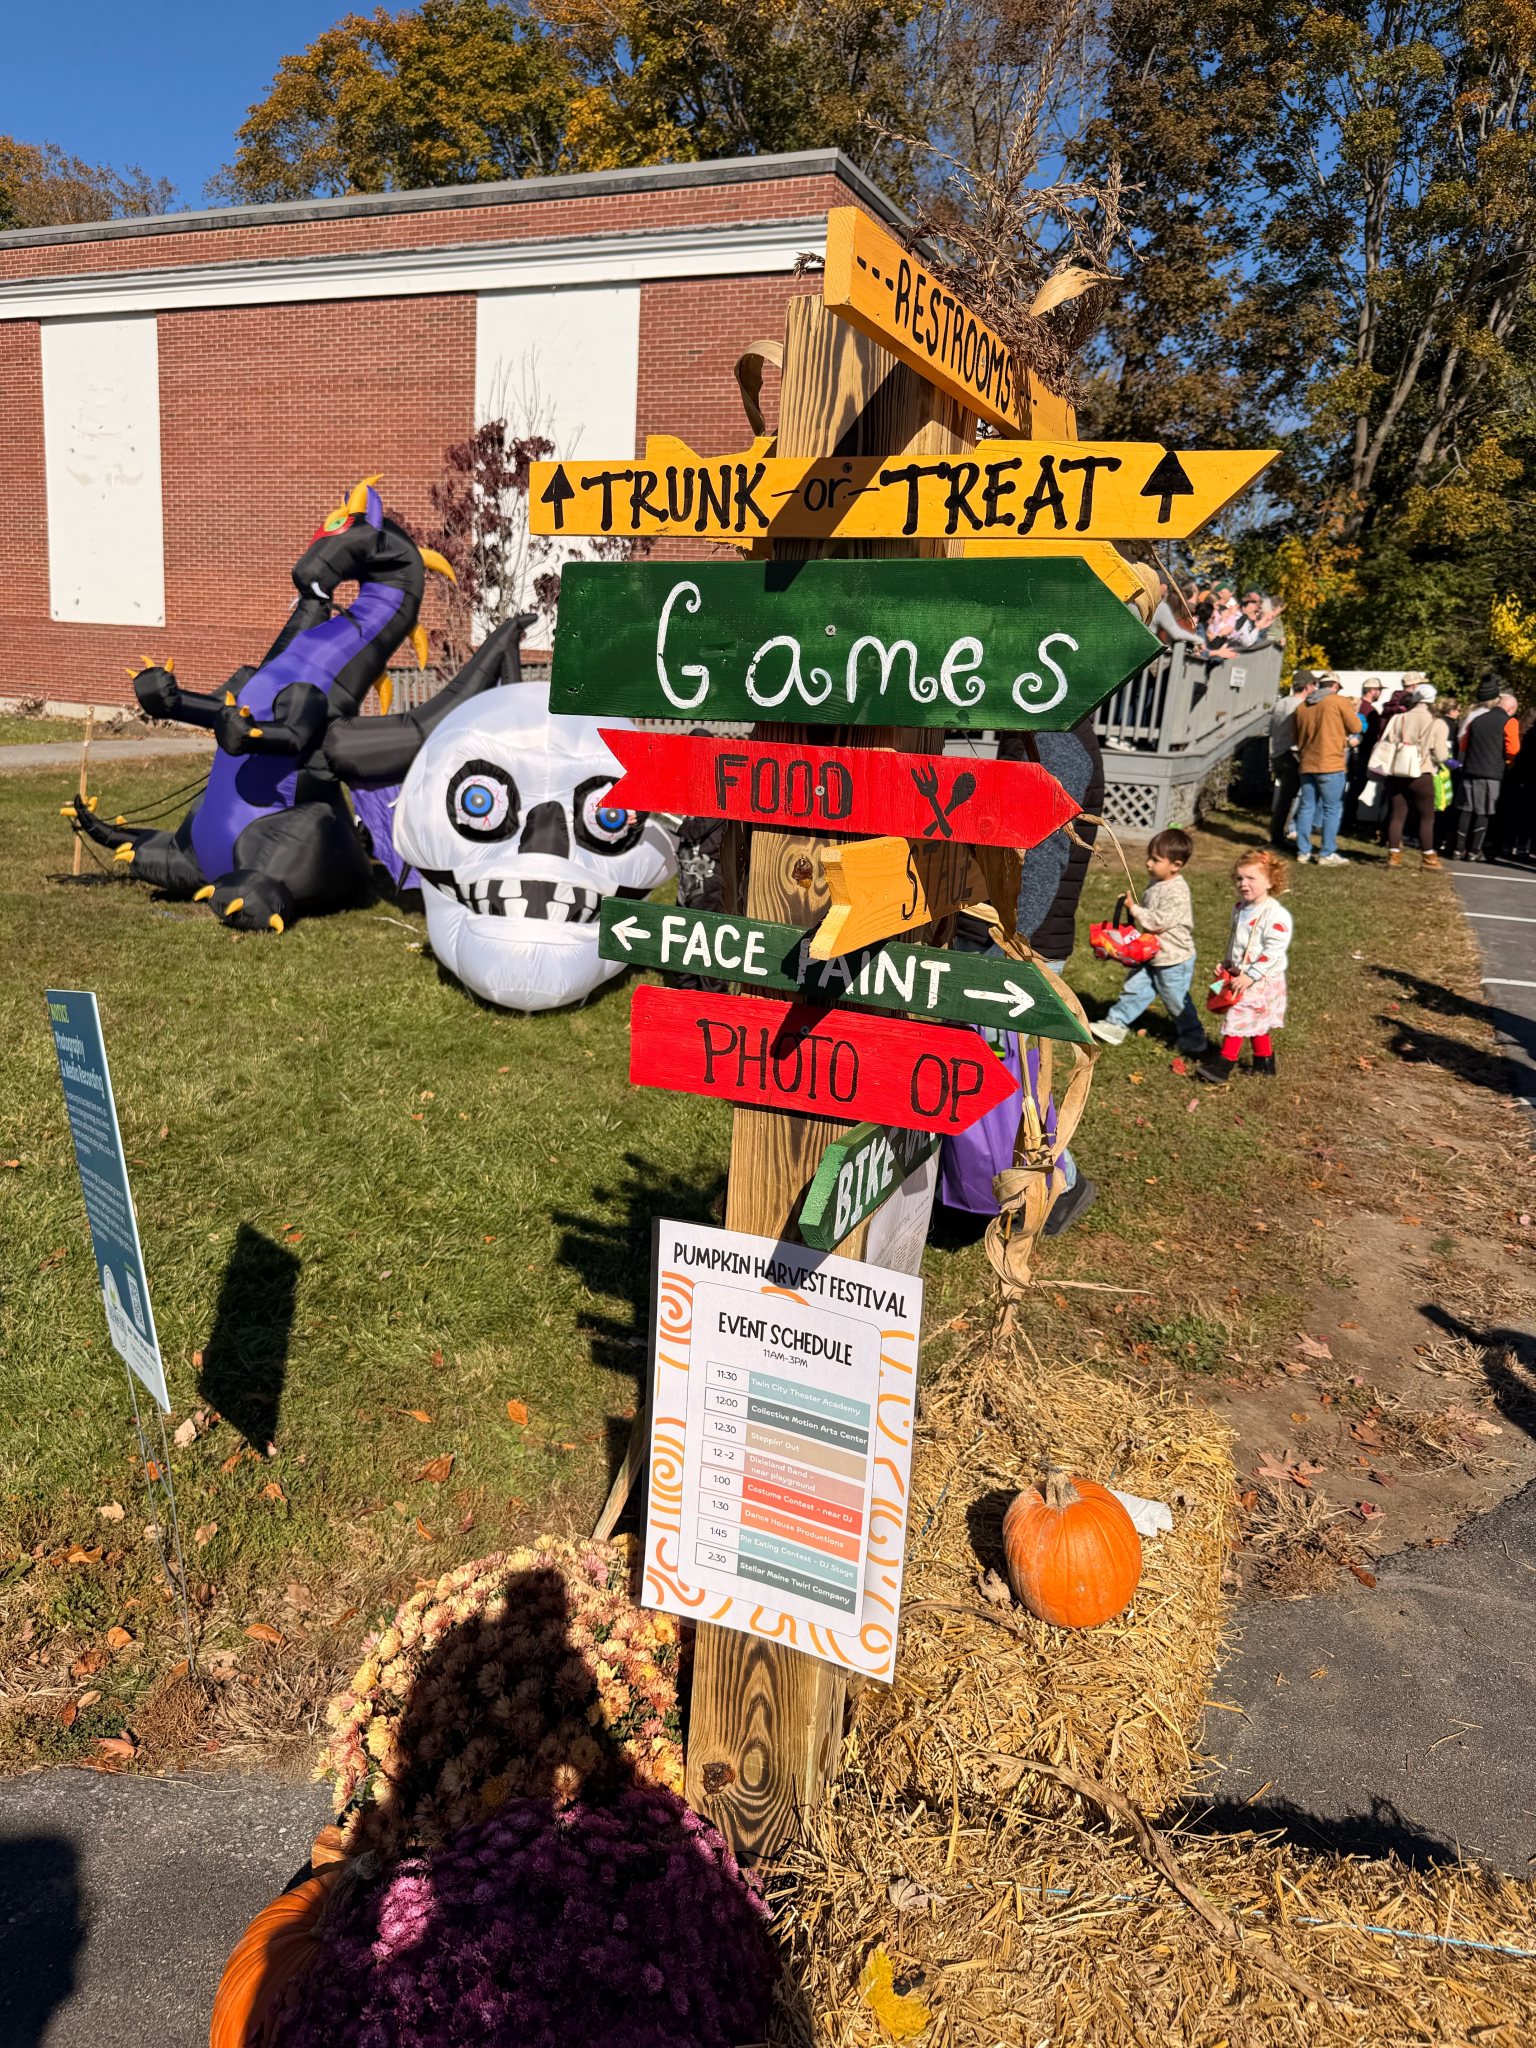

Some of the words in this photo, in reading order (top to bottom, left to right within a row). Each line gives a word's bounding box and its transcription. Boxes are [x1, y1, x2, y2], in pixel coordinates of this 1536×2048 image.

[582, 463, 770, 533] TRUNK
[879, 455, 1122, 536] TREAT
[656, 581, 1080, 714] Games
[714, 753, 853, 821] FOOD
[661, 915, 768, 977] FACE
[796, 938, 951, 1009] PAINT
[696, 1017, 860, 1103] PHOTO
[910, 1053, 984, 1124] OP
[834, 1129, 899, 1240] BIKE
[673, 1242, 750, 1275] PUMPKIN
[754, 1257, 828, 1294] HARVEST
[830, 1276, 908, 1319] FESTIVAL
[718, 1312, 768, 1343] EVENT
[770, 1324, 853, 1367] SCHEDULE
[763, 1349, 809, 1368] 11AM-3PM
[717, 1370, 738, 1382] 11:30
[716, 1396, 738, 1408] 12:00
[751, 1378, 770, 1389] Twin
[772, 1383, 788, 1395] City
[790, 1388, 822, 1403] Theater
[823, 1398, 861, 1416] Academy
[714, 1422, 736, 1434] 12:30
[751, 1405, 790, 1422] Collective
[791, 1416, 818, 1430] Motion
[820, 1425, 838, 1436] Arts
[840, 1430, 868, 1445] Center
[750, 1455, 786, 1472] Dixieland
[787, 1466, 808, 1478] Band
[785, 1442, 800, 1452] Out
[713, 1475, 731, 1486] 1:00
[751, 1467, 769, 1477] near
[770, 1473, 815, 1492] playground
[712, 1500, 729, 1511] 1:30
[748, 1484, 782, 1500] Costume
[783, 1495, 814, 1512] Contest
[822, 1508, 841, 1519] near
[842, 1514, 853, 1523] DJ
[710, 1527, 728, 1538] 1:45
[744, 1509, 769, 1523] Dance
[771, 1516, 795, 1530] House
[796, 1526, 844, 1548] Productions
[708, 1552, 726, 1563] 2:30
[740, 1534, 752, 1543] Pie
[754, 1538, 779, 1554] Eating
[781, 1547, 812, 1562] Contest
[819, 1560, 829, 1569] DJ
[830, 1564, 854, 1578] Stage
[740, 1562, 765, 1576] Stellar
[767, 1570, 790, 1583] Maine
[791, 1578, 810, 1590] Twirl
[812, 1585, 850, 1604] Company
